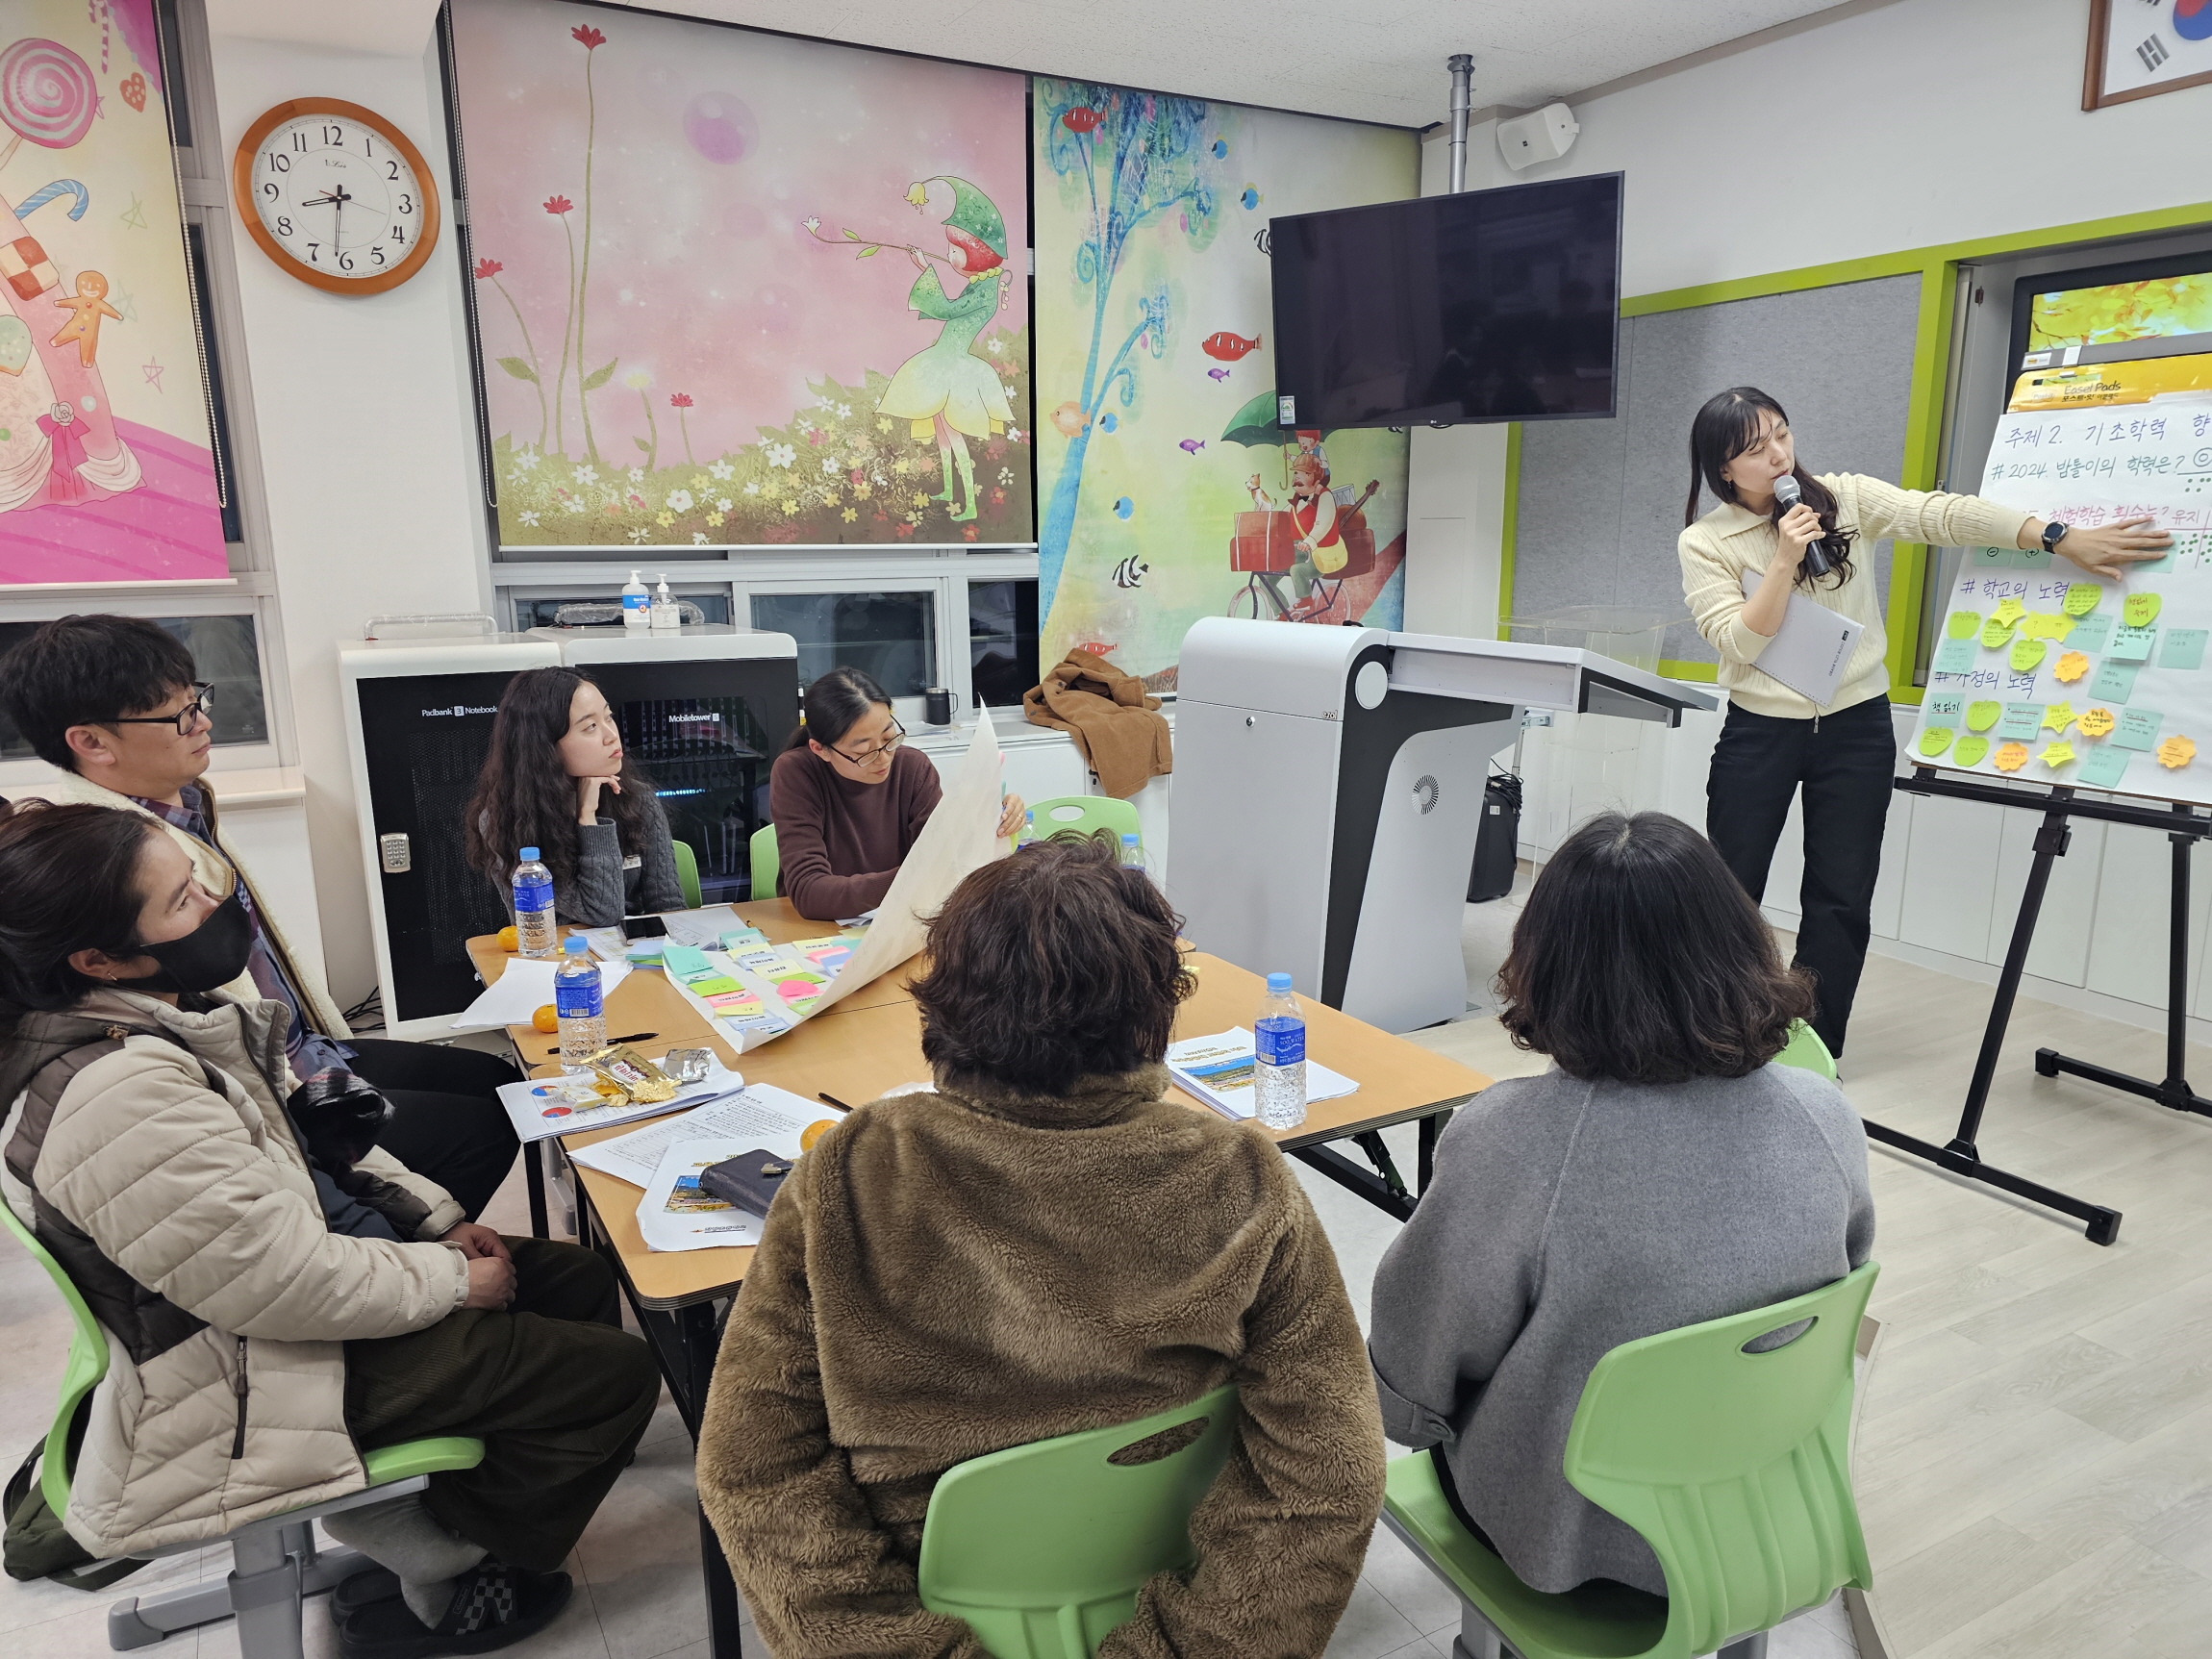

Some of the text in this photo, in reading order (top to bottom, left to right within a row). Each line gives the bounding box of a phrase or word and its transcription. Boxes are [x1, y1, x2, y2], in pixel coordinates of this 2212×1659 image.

[292, 133, 308, 152] 11
[323, 126, 343, 146] 12
[365, 138, 372, 158] 1
[269, 153, 290, 173] 10
[386, 161, 399, 181] 2
[264, 183, 280, 203] 9
[398, 194, 413, 214] 3
[277, 216, 293, 237] 8
[391, 225, 406, 244] 4
[306, 242, 320, 262] 7
[339, 251, 354, 270] 6
[371, 246, 386, 265] 5
[2064, 381, 2122, 395] Easel Pads
[2005, 425, 2043, 448] 주제
[2049, 425, 2063, 444] 2.
[2085, 417, 2168, 446] 기초학력
[2049, 505, 2106, 526] 체험학습
[2172, 510, 2200, 525] 유지
[1983, 578, 2028, 600] 학교의
[2039, 581, 2071, 606] 노력
[2006, 673, 2037, 699] 노력
[421, 707, 453, 717] Padbank
[465, 704, 498, 715] Notebook
[668, 713, 712, 723] Mobiletower
[1321, 709, 1339, 719] esol
